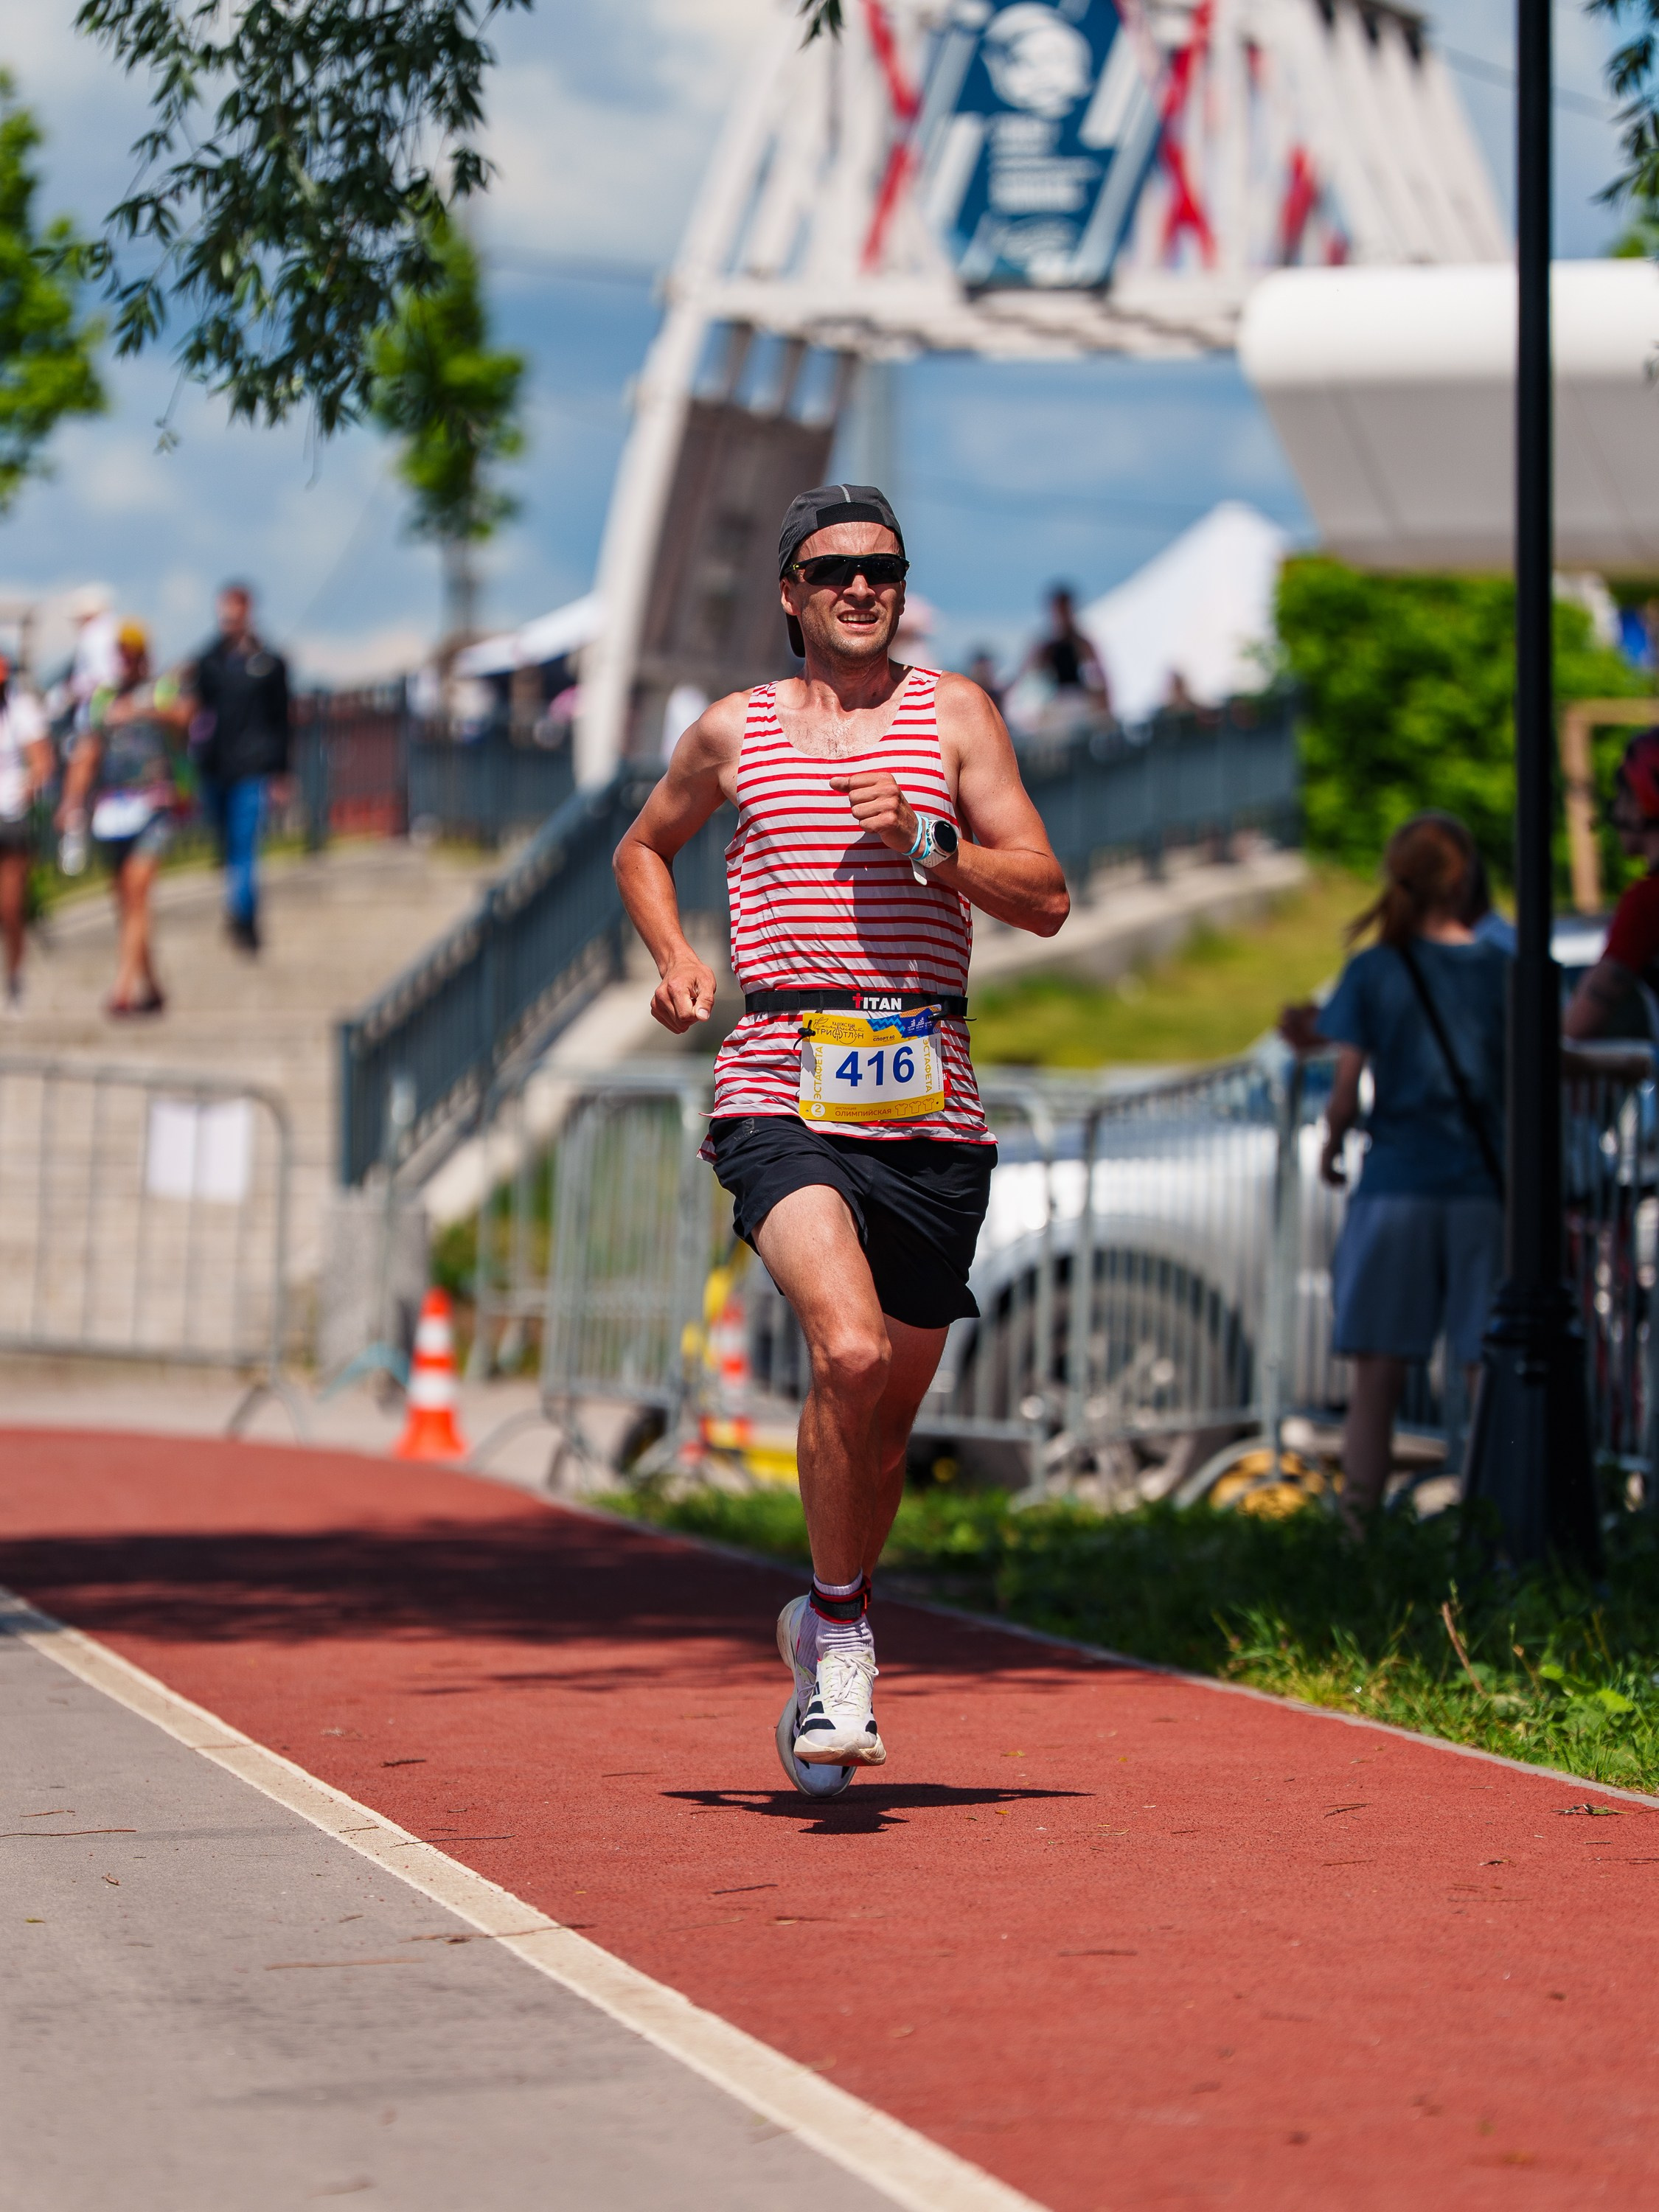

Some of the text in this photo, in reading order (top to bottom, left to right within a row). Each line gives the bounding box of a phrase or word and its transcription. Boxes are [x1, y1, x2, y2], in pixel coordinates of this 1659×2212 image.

[813, 1046, 824, 1100] ЭСТАФЕТА
[835, 1046, 914, 1087] 416
[922, 1038, 933, 1093] ЭСТАФЕТА
[815, 1104, 821, 1113] 2
[835, 1108, 891, 1117] ОЛИМПИЙСКАЯ
